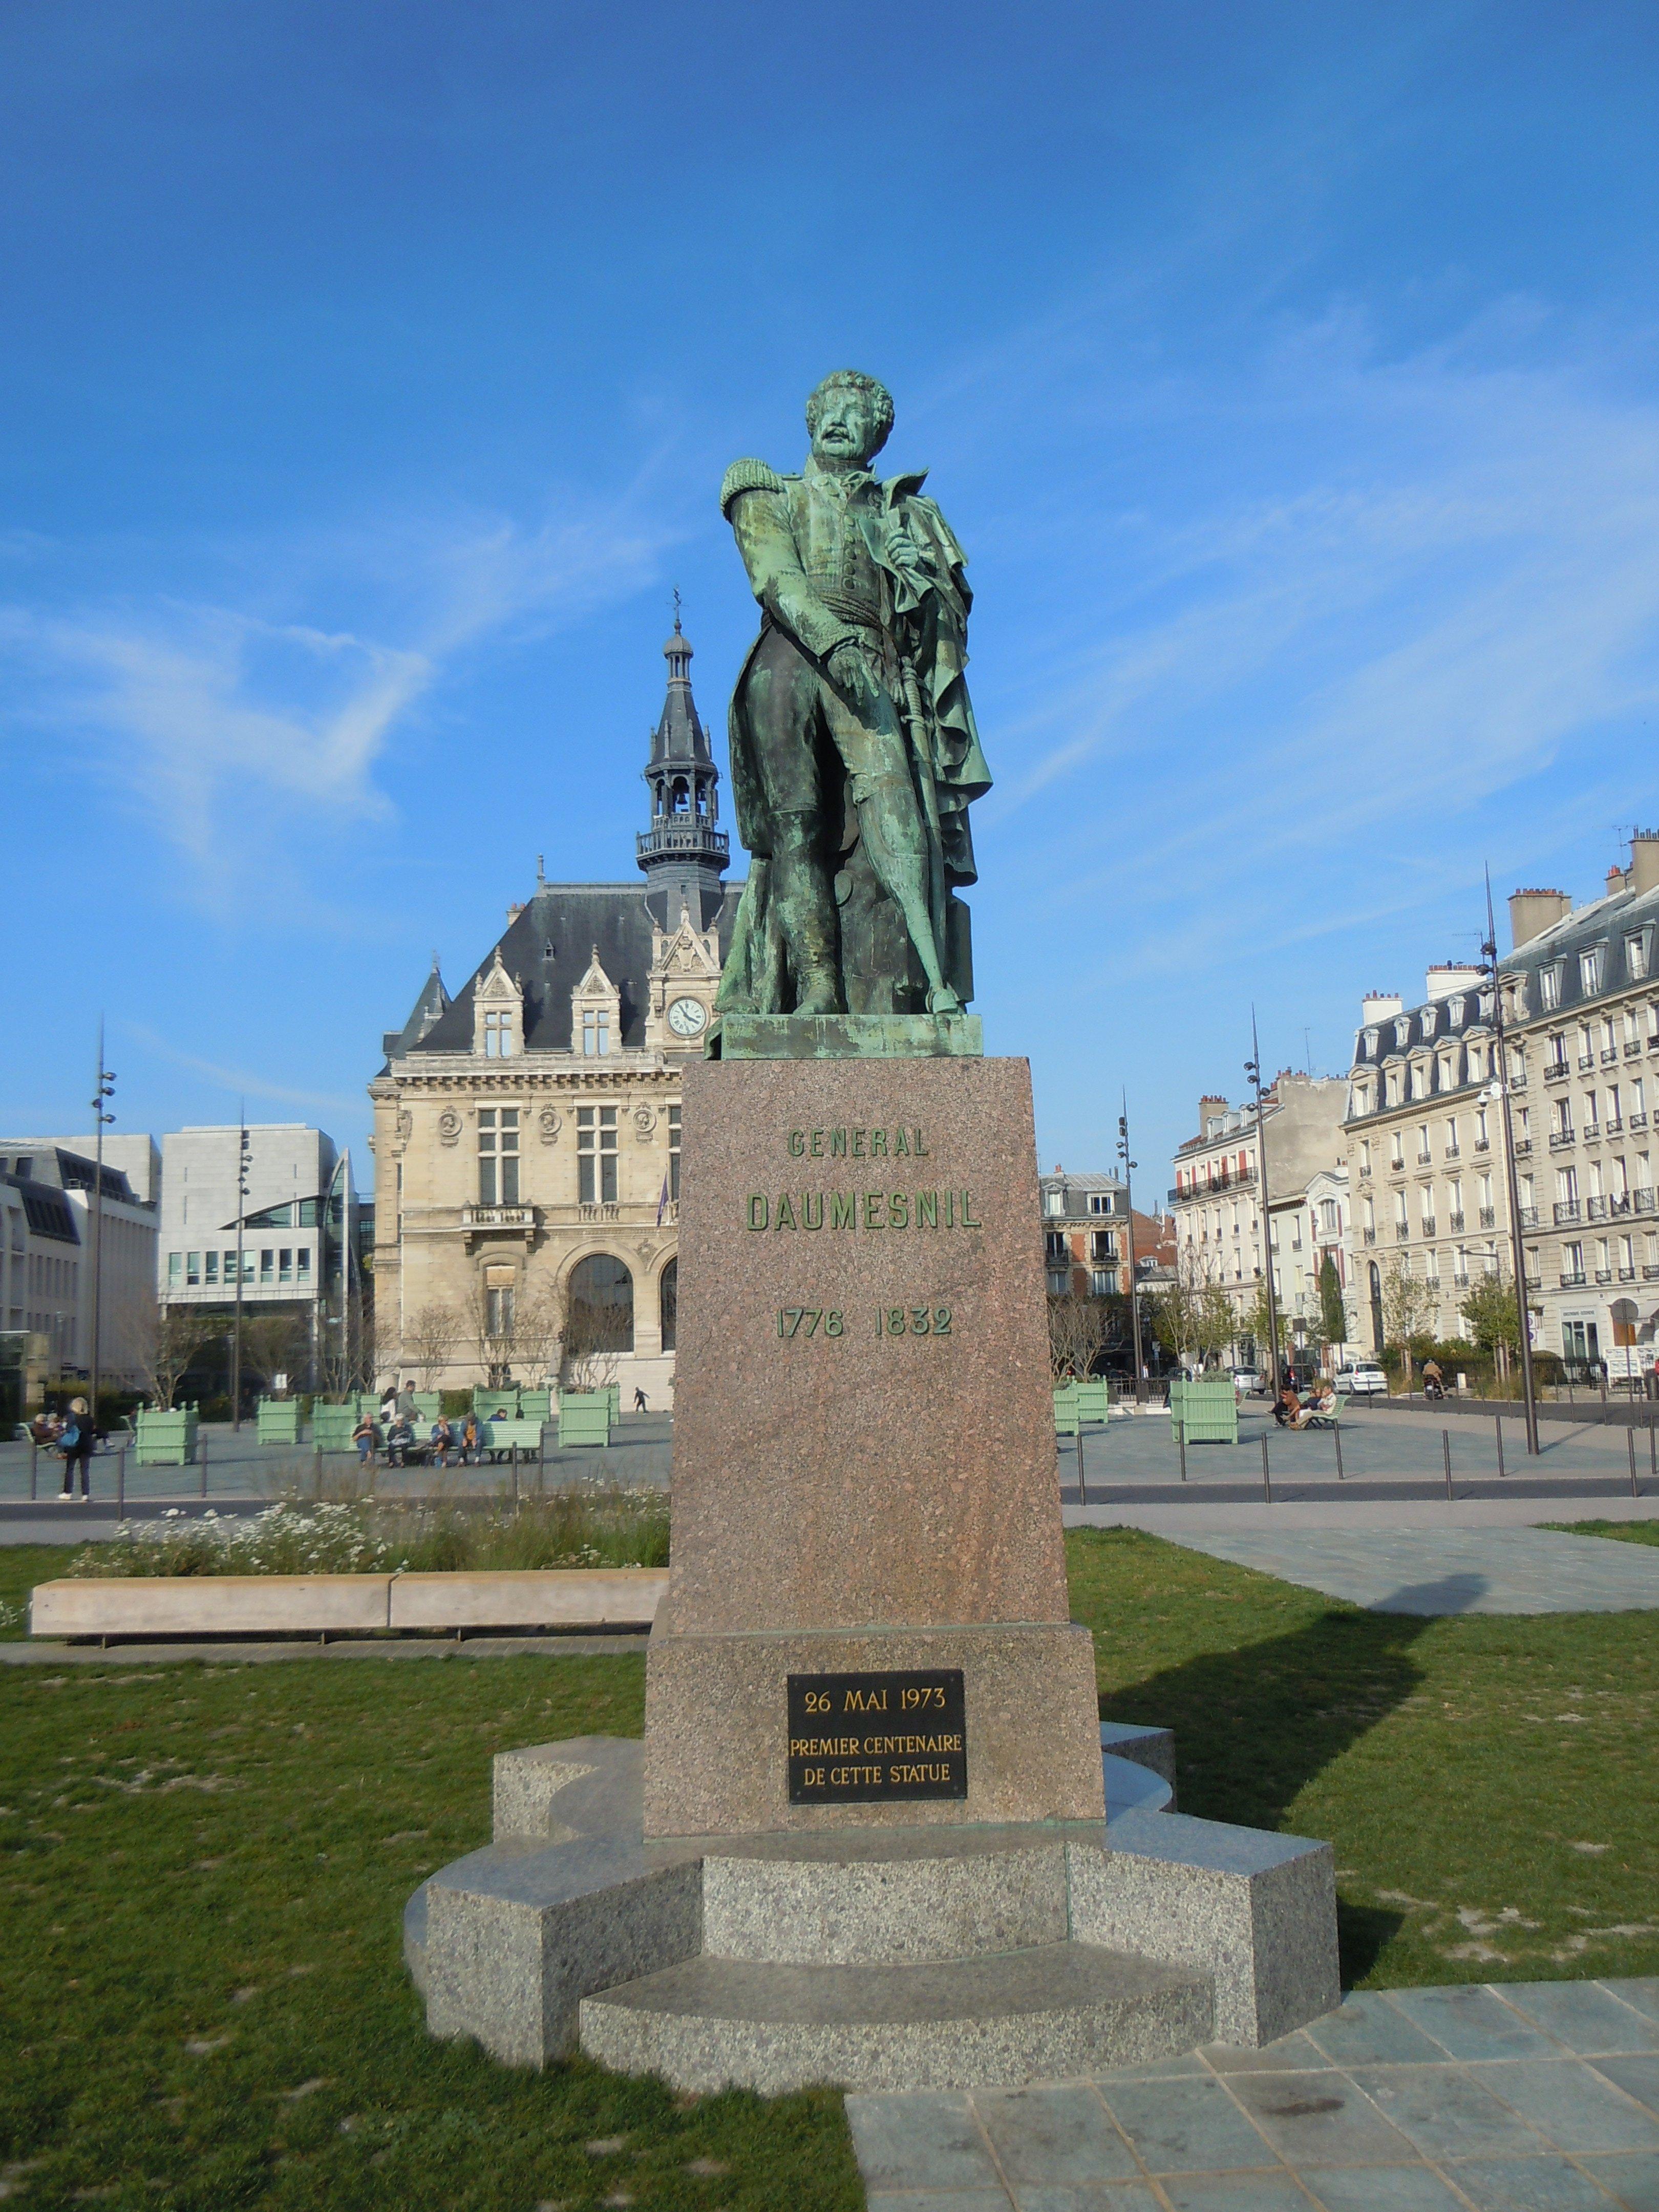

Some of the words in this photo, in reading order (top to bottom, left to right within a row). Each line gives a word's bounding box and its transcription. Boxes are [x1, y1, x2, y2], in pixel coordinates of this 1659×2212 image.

[788, 1128, 928, 1157] GENERAL
[747, 1190, 982, 1230] DAUMESNIL
[777, 1308, 843, 1336] 1776
[876, 1307, 951, 1334] 1832
[804, 1691, 831, 1713] 26
[843, 1689, 888, 1711] MAI
[901, 1687, 946, 1709] 1973
[790, 1737, 860, 1757] PREMIER
[863, 1734, 962, 1755] CENTENAIRE
[804, 1768, 825, 1786] DE
[831, 1766, 882, 1784] CETTE
[890, 1763, 950, 1783] STATUE
